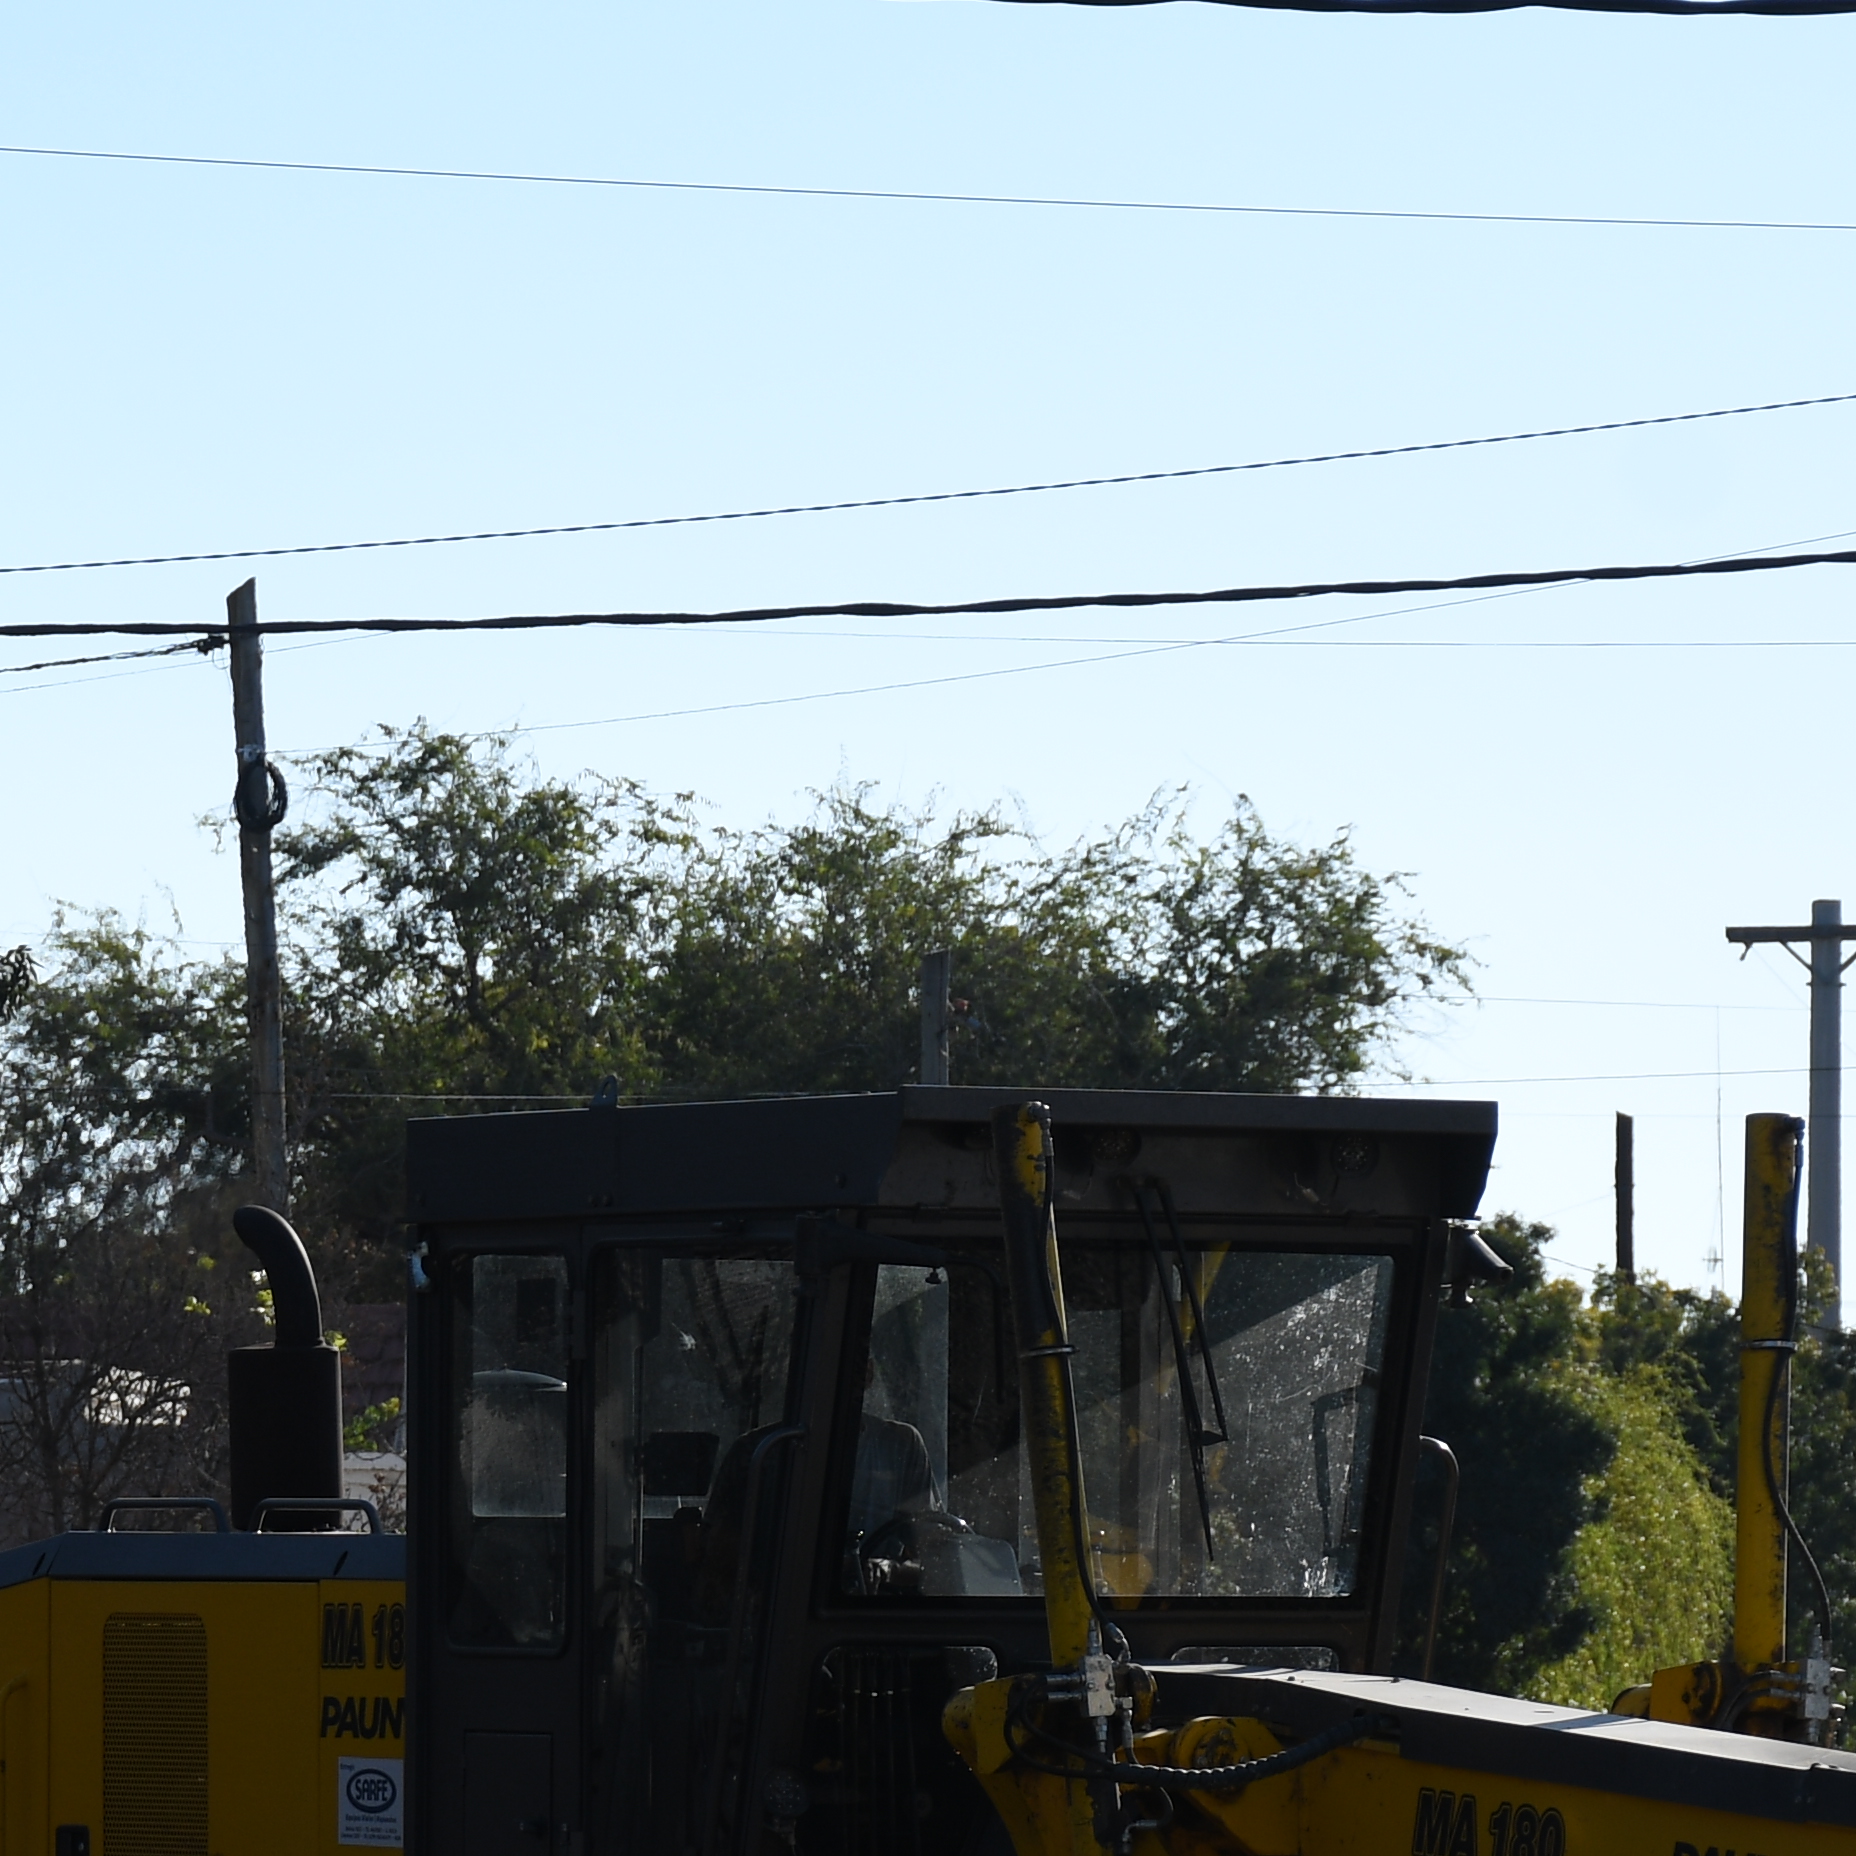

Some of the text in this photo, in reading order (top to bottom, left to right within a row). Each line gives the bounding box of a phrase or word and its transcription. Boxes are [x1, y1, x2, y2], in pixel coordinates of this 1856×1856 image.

[322, 1603, 405, 1670] MA 18
[321, 1697, 405, 1738] PAUN
[355, 1778, 388, 1802] SARFE
